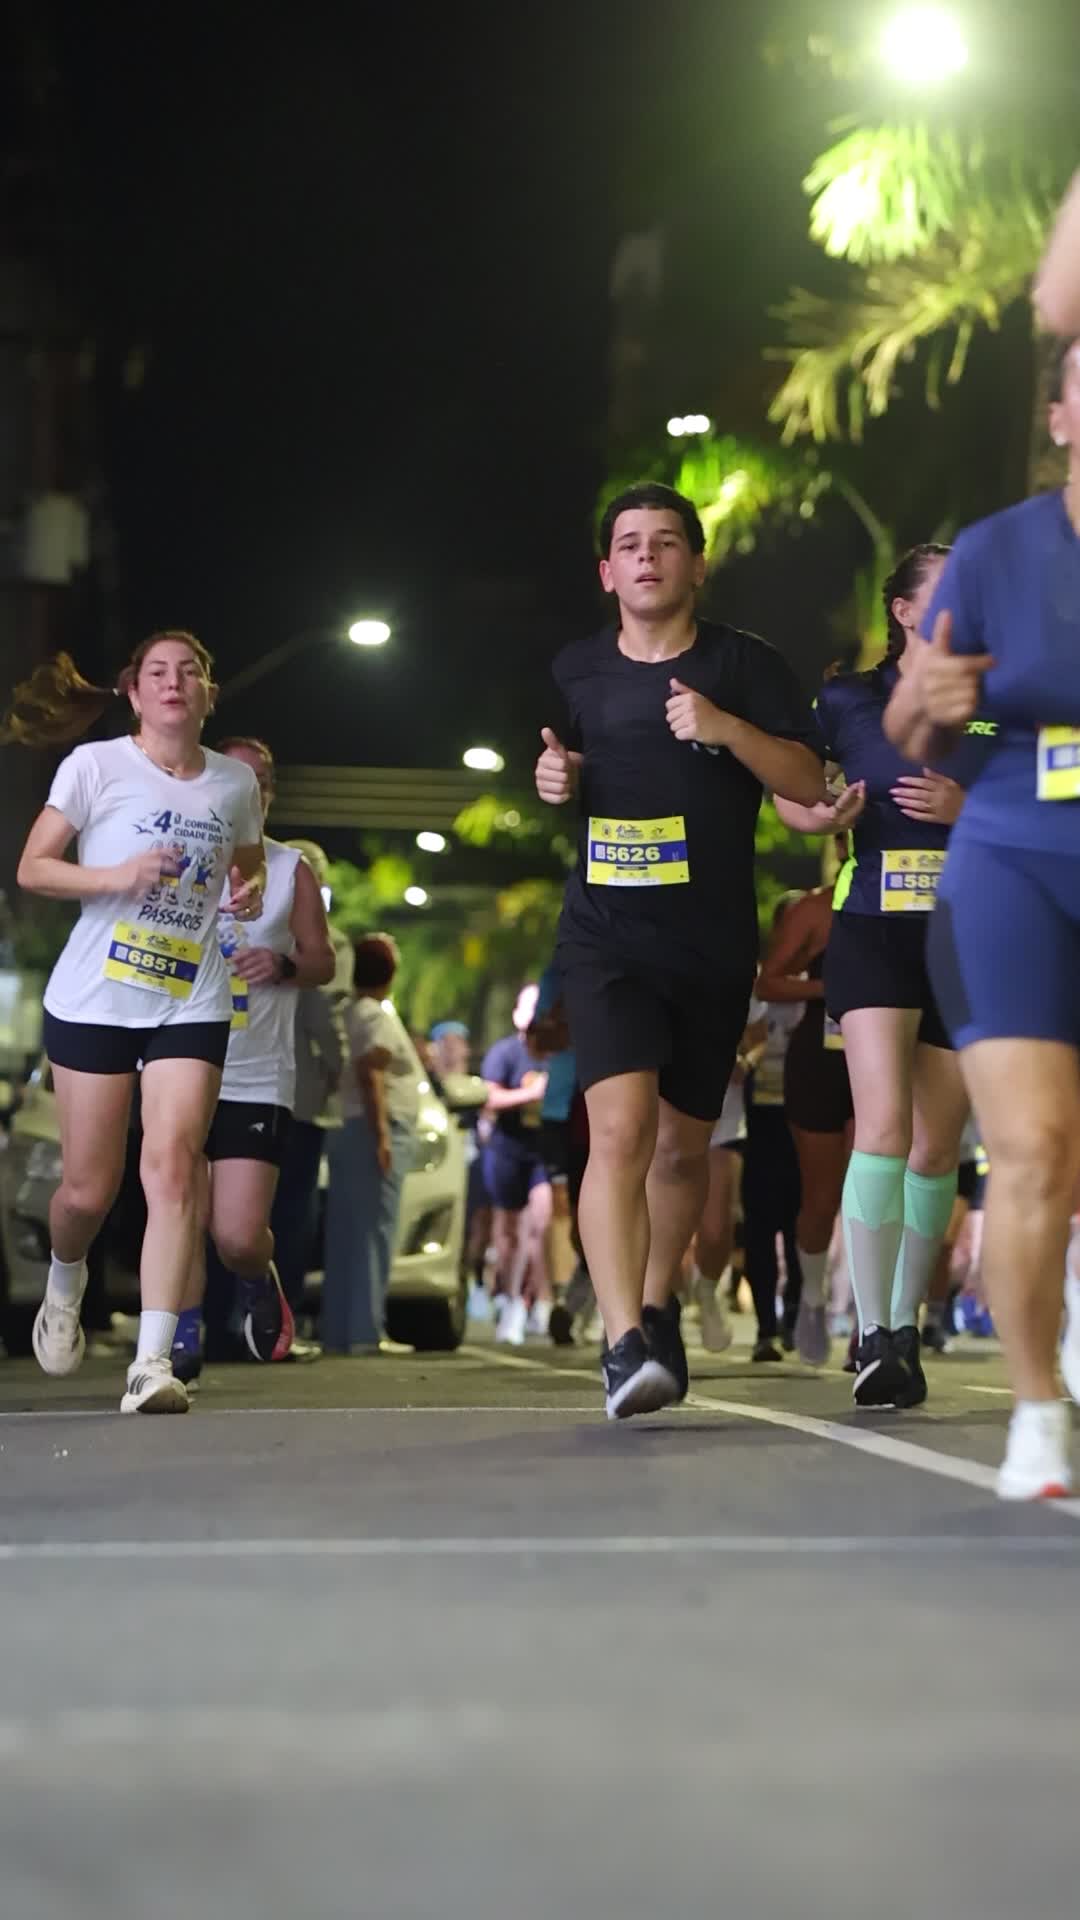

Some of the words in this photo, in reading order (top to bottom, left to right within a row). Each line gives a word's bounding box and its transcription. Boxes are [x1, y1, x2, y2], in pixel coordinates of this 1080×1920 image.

[174, 827, 206, 840] CIDADE
[184, 819, 222, 834] CORRIDA
[606, 846, 661, 862] 5626
[127, 949, 177, 975] 6851
